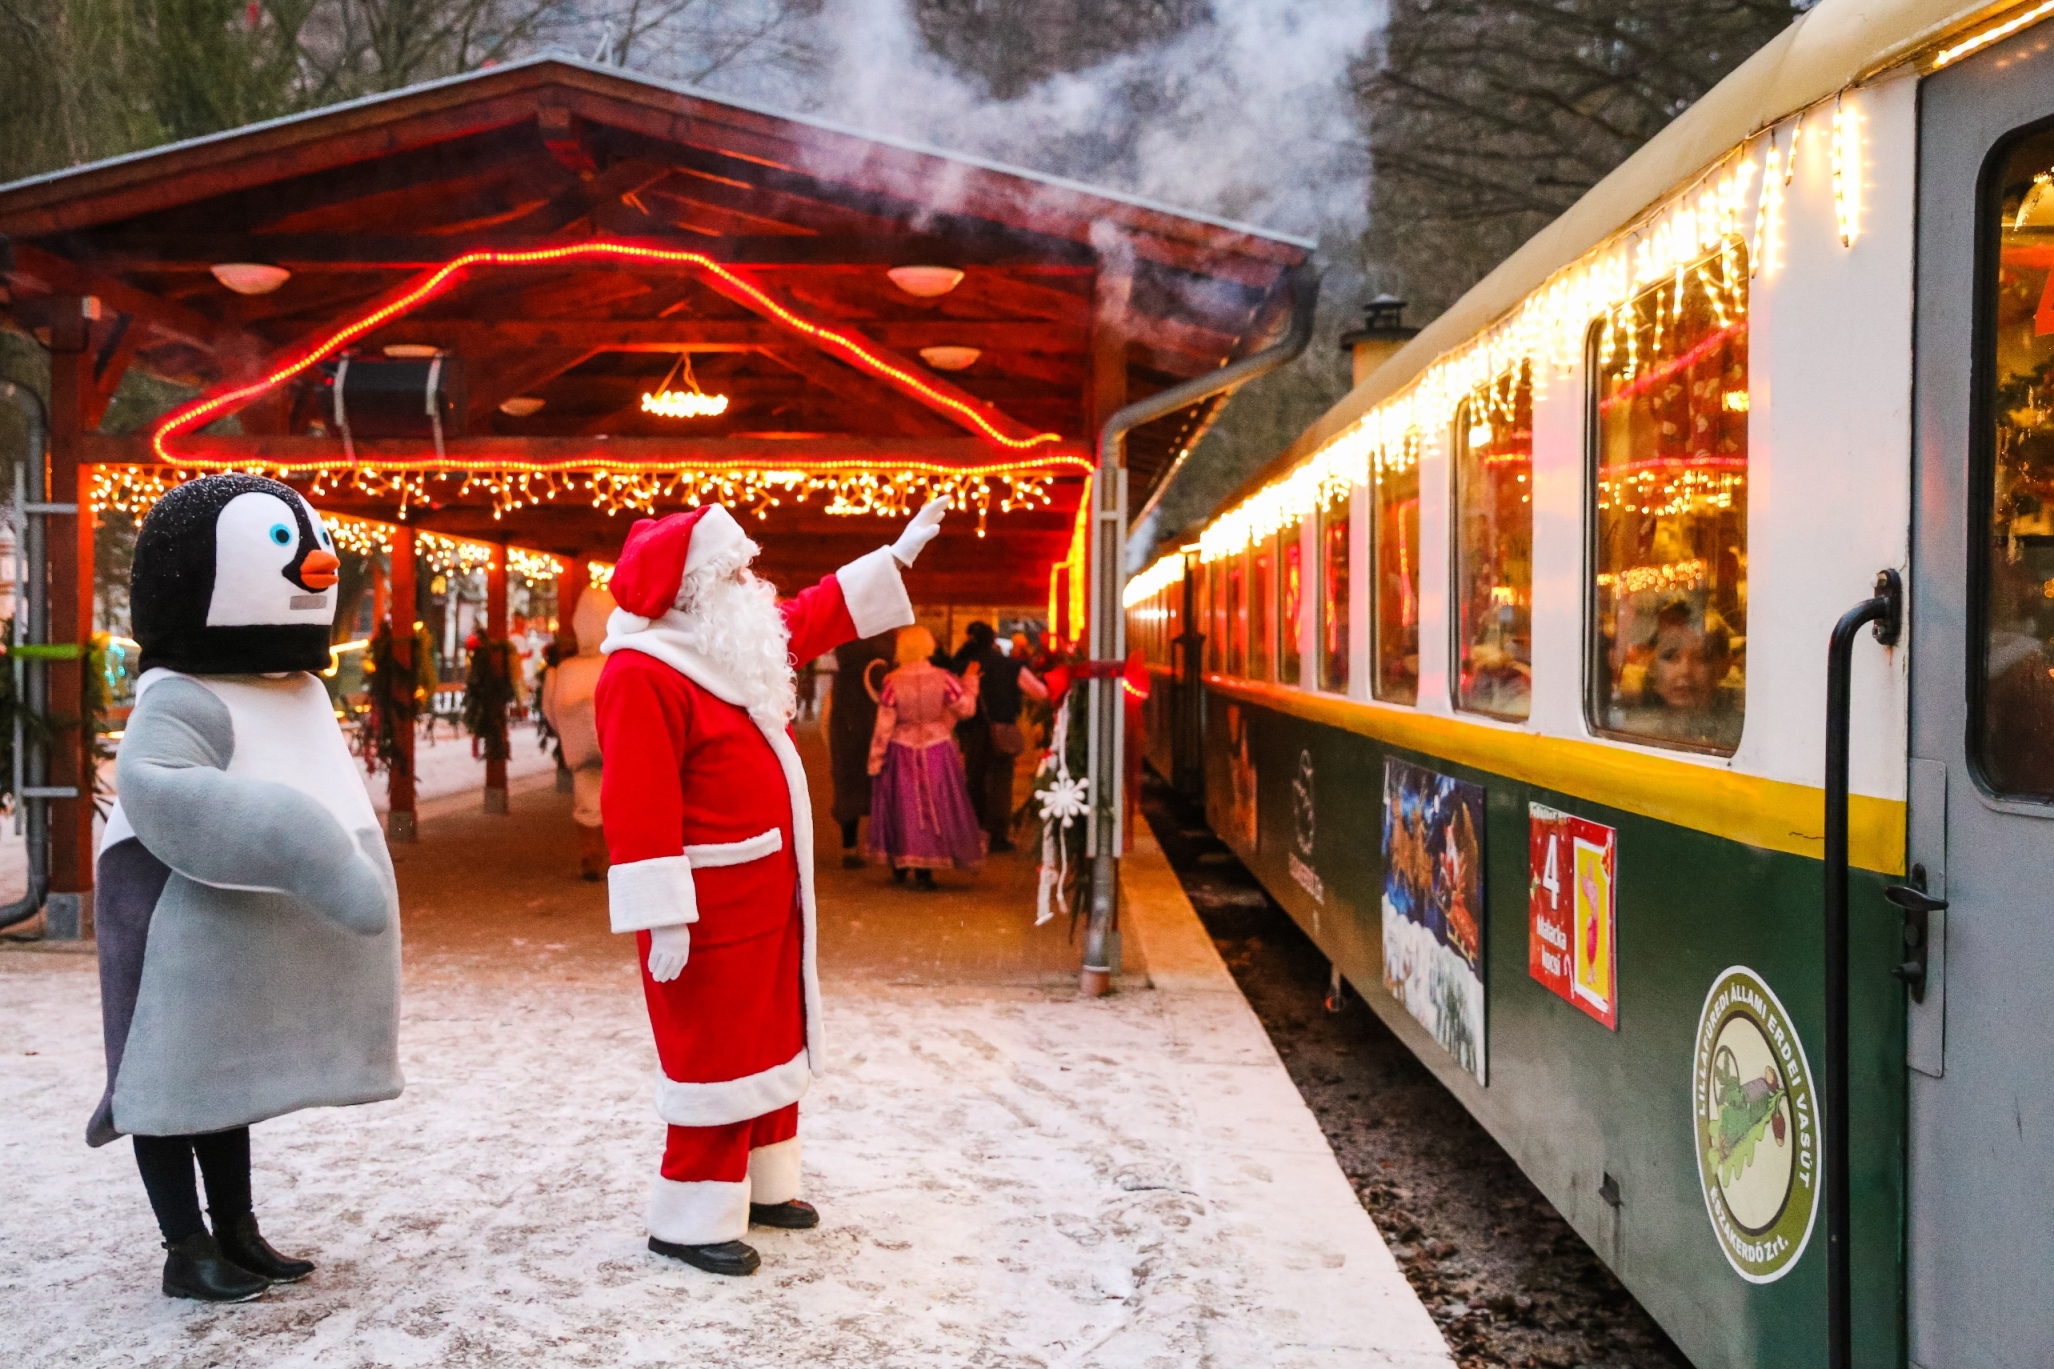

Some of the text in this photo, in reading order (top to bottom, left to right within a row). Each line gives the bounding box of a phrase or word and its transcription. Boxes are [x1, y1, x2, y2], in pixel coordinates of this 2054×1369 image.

[1543, 833, 1560, 911] 4
[1698, 982, 1813, 1188] LILLAFÜREDI ÁLLAMI ERDEI VASÚT
[1764, 1235, 1789, 1261] Zrt.
